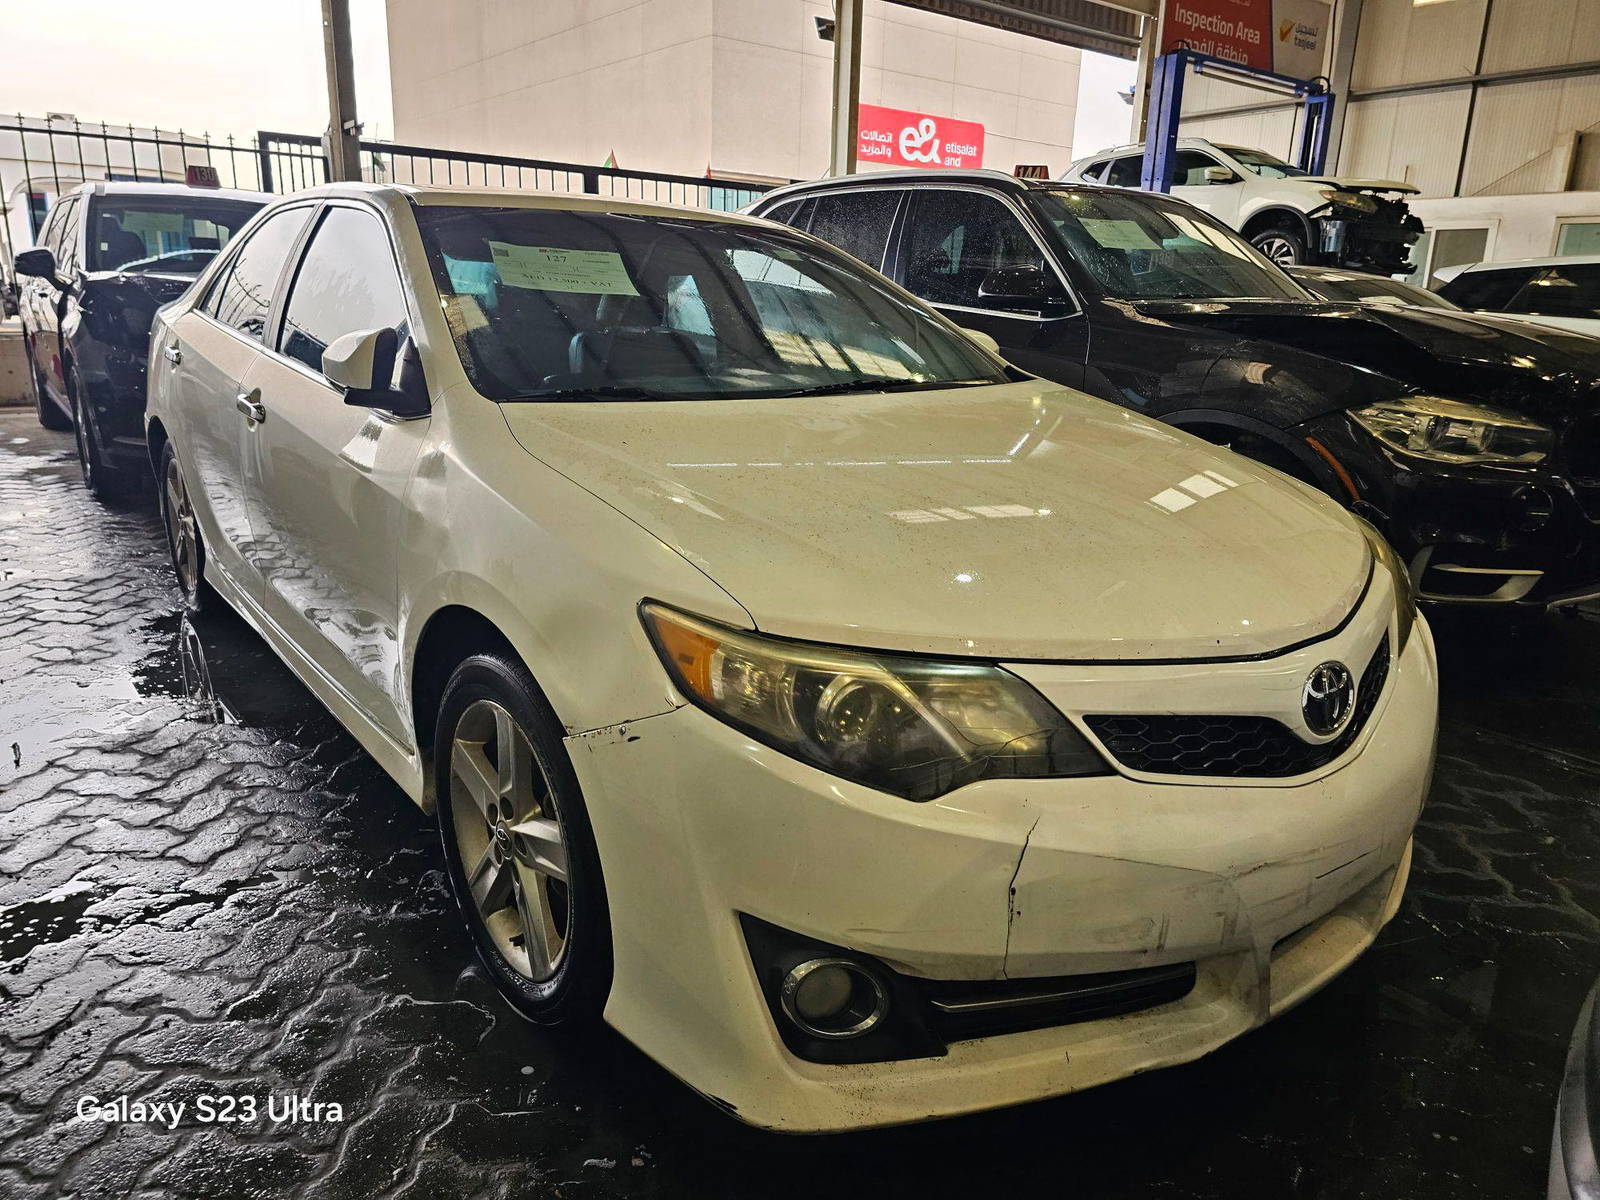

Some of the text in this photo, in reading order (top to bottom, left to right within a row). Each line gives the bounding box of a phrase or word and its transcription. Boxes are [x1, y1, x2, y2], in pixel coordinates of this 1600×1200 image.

[1174, 3, 1261, 45] Inspection Area
[860, 130, 893, 143] اتصالات
[860, 144, 892, 158] والمزيد
[945, 142, 977, 156] etisalat
[944, 155, 961, 167] and
[546, 254, 567, 264] 127
